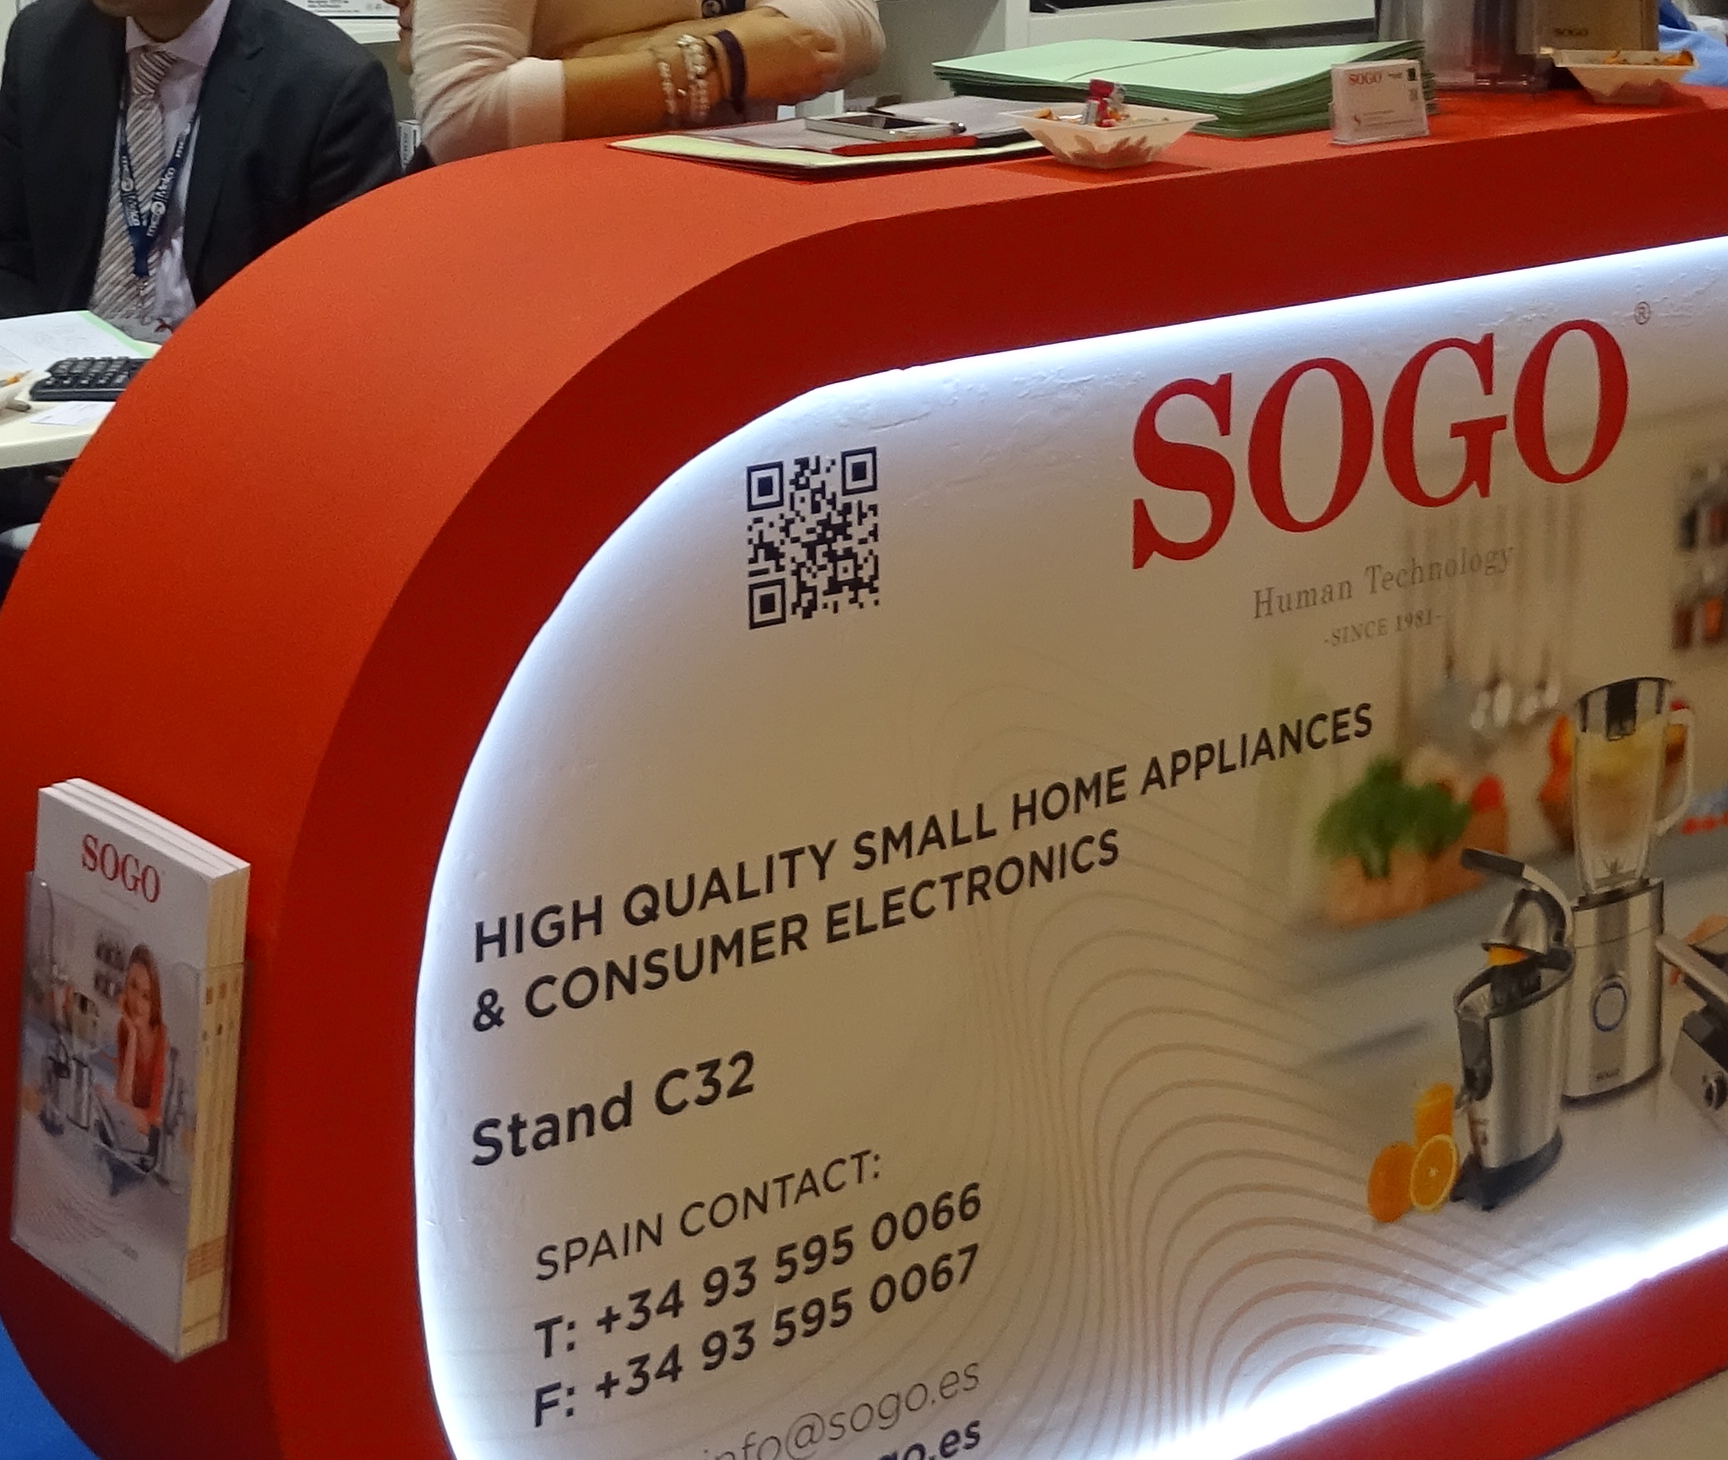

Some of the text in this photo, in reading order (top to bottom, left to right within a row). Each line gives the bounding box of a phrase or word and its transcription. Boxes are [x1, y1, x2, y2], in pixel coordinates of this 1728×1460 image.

[1348, 71, 1383, 86] SOGO
[1131, 318, 1628, 572] SOGO
[1252, 541, 1514, 623] Human Technology
[81, 833, 162, 904] SOGO
[473, 701, 1374, 964] HIGH QUALITY SMALL HOME APPLIANCES
[472, 828, 1120, 1033] & CONSUMER ELECTRONICS
[470, 1048, 757, 1167] Stand C32
[534, 1148, 881, 1282] SPAIN CONTACT:
[534, 1181, 982, 1360] T: +34 93 595 0066
[533, 1243, 980, 1428] F: +34 93 595 0067
[702, 1363, 980, 1460] fo@sogo.es
